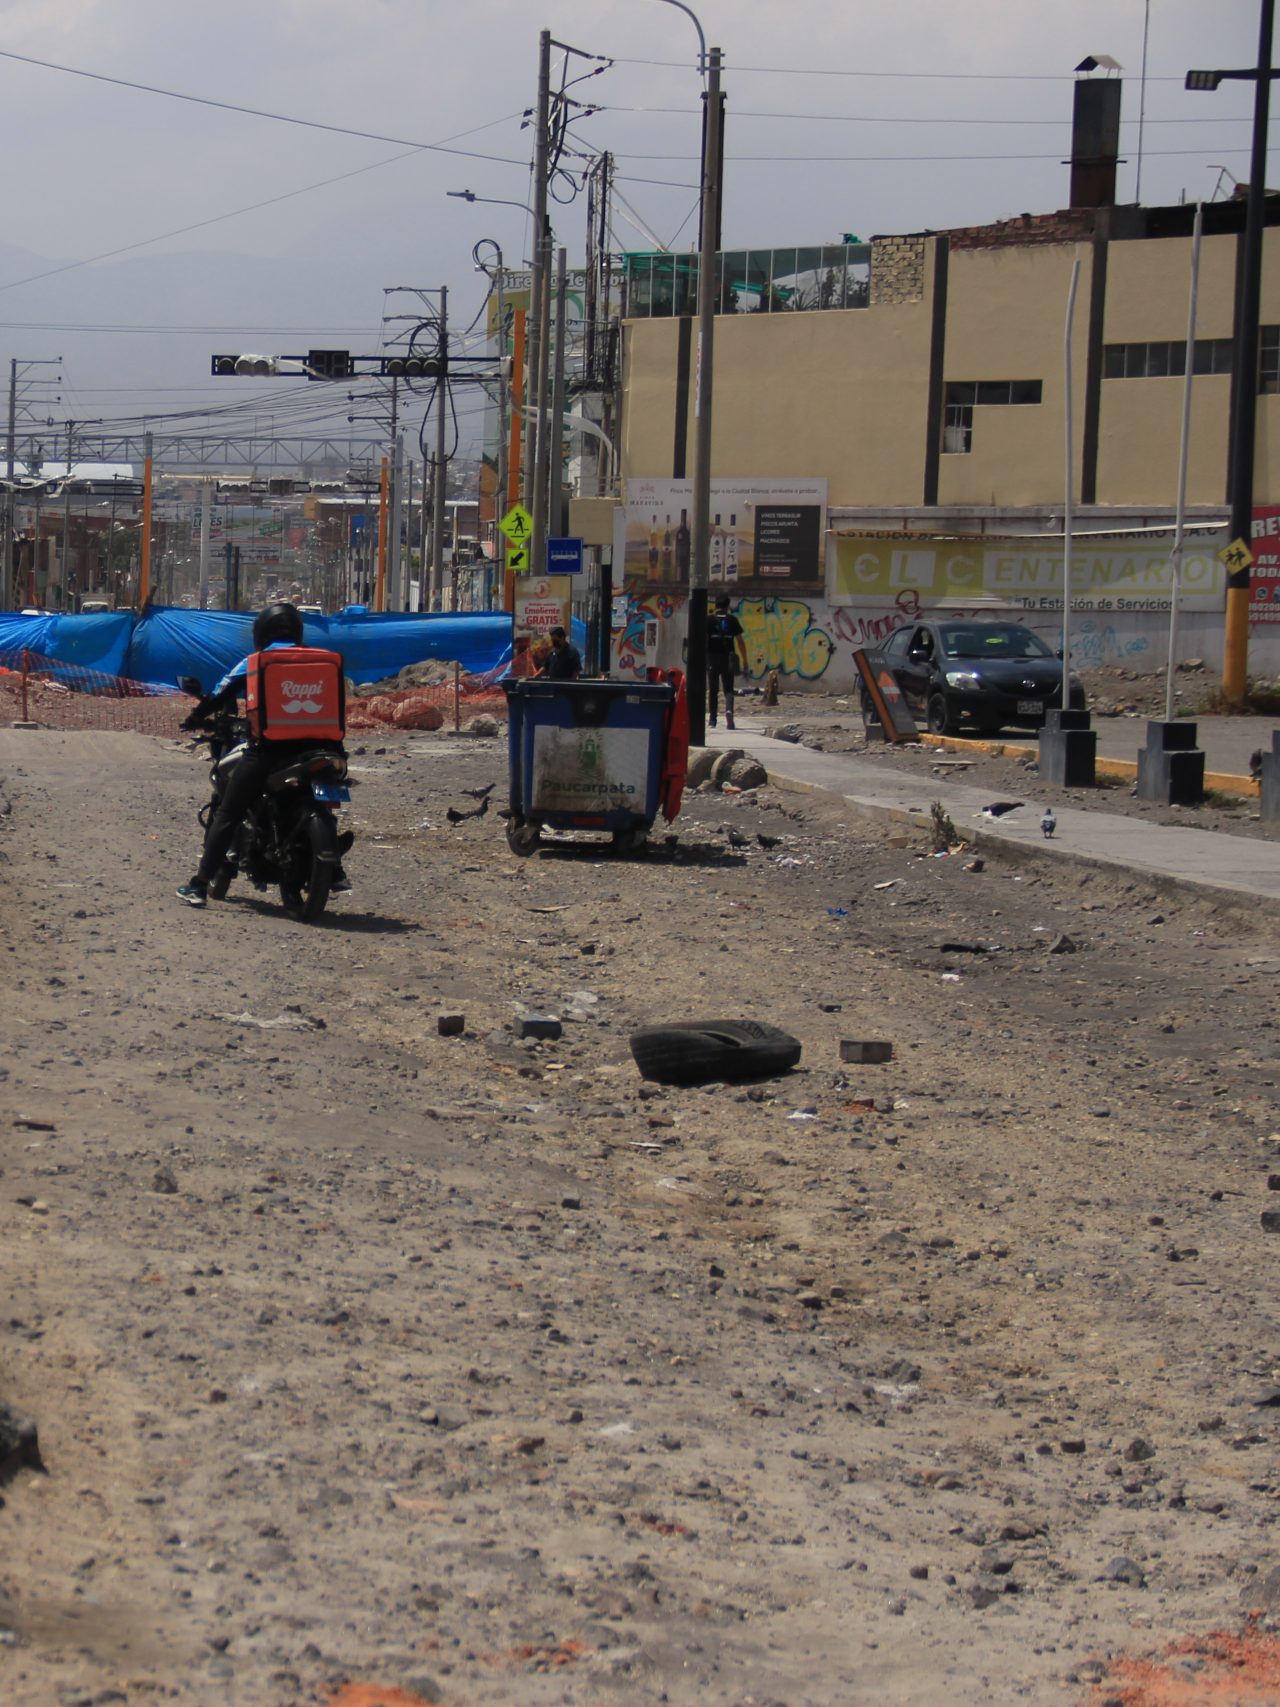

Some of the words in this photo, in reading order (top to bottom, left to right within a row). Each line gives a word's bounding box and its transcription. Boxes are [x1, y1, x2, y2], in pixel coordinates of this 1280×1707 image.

[1097, 597, 1113, 610] de
[525, 615, 560, 626] GRATIS
[281, 680, 323, 699] Rappi
[542, 780, 636, 796] Paucarpata
